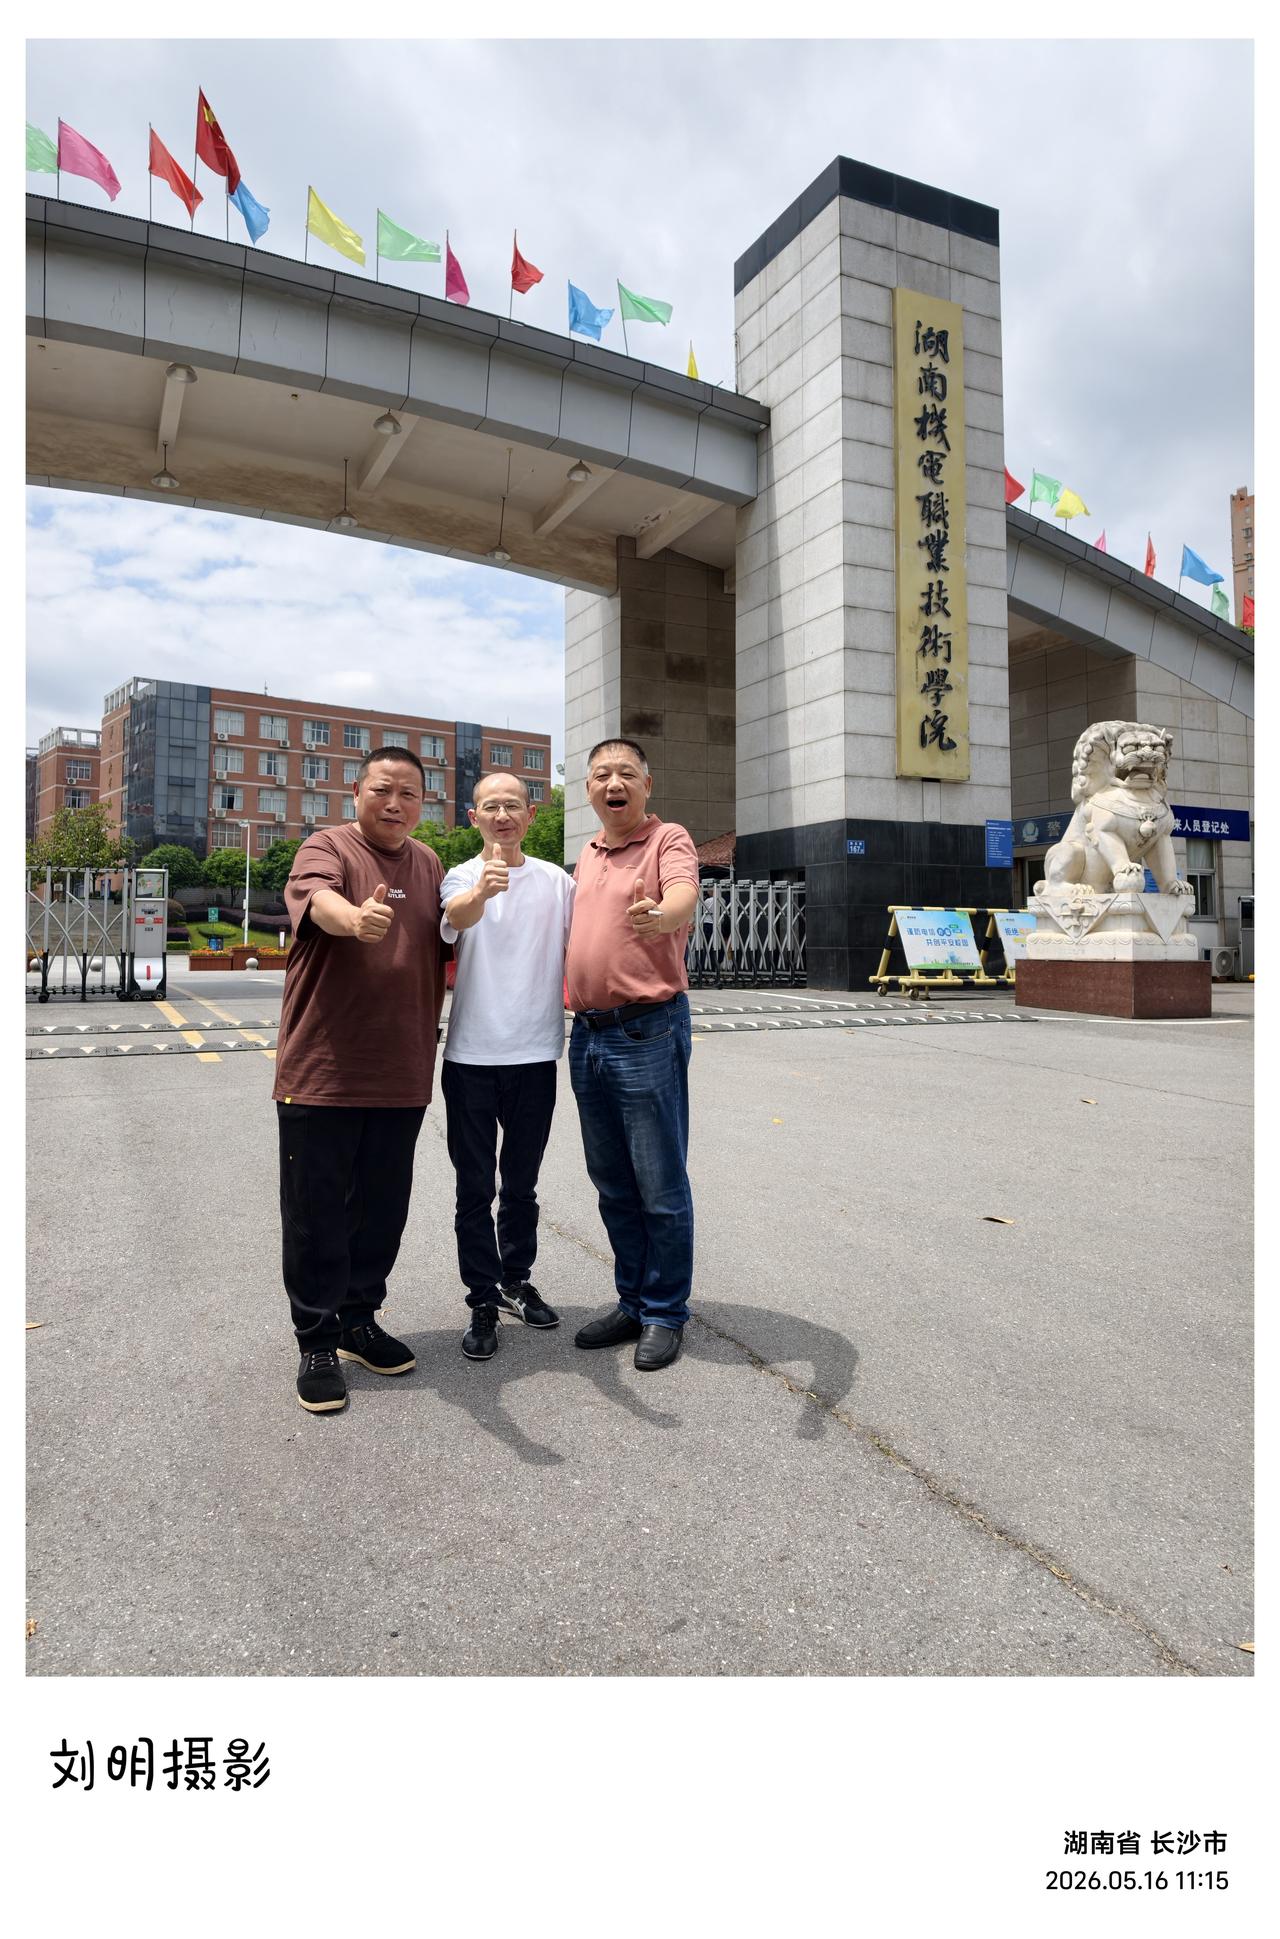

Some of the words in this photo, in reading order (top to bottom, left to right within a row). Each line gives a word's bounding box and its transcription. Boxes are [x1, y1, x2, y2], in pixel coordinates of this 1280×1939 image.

[1173, 818, 1230, 834] 来人员登记处
